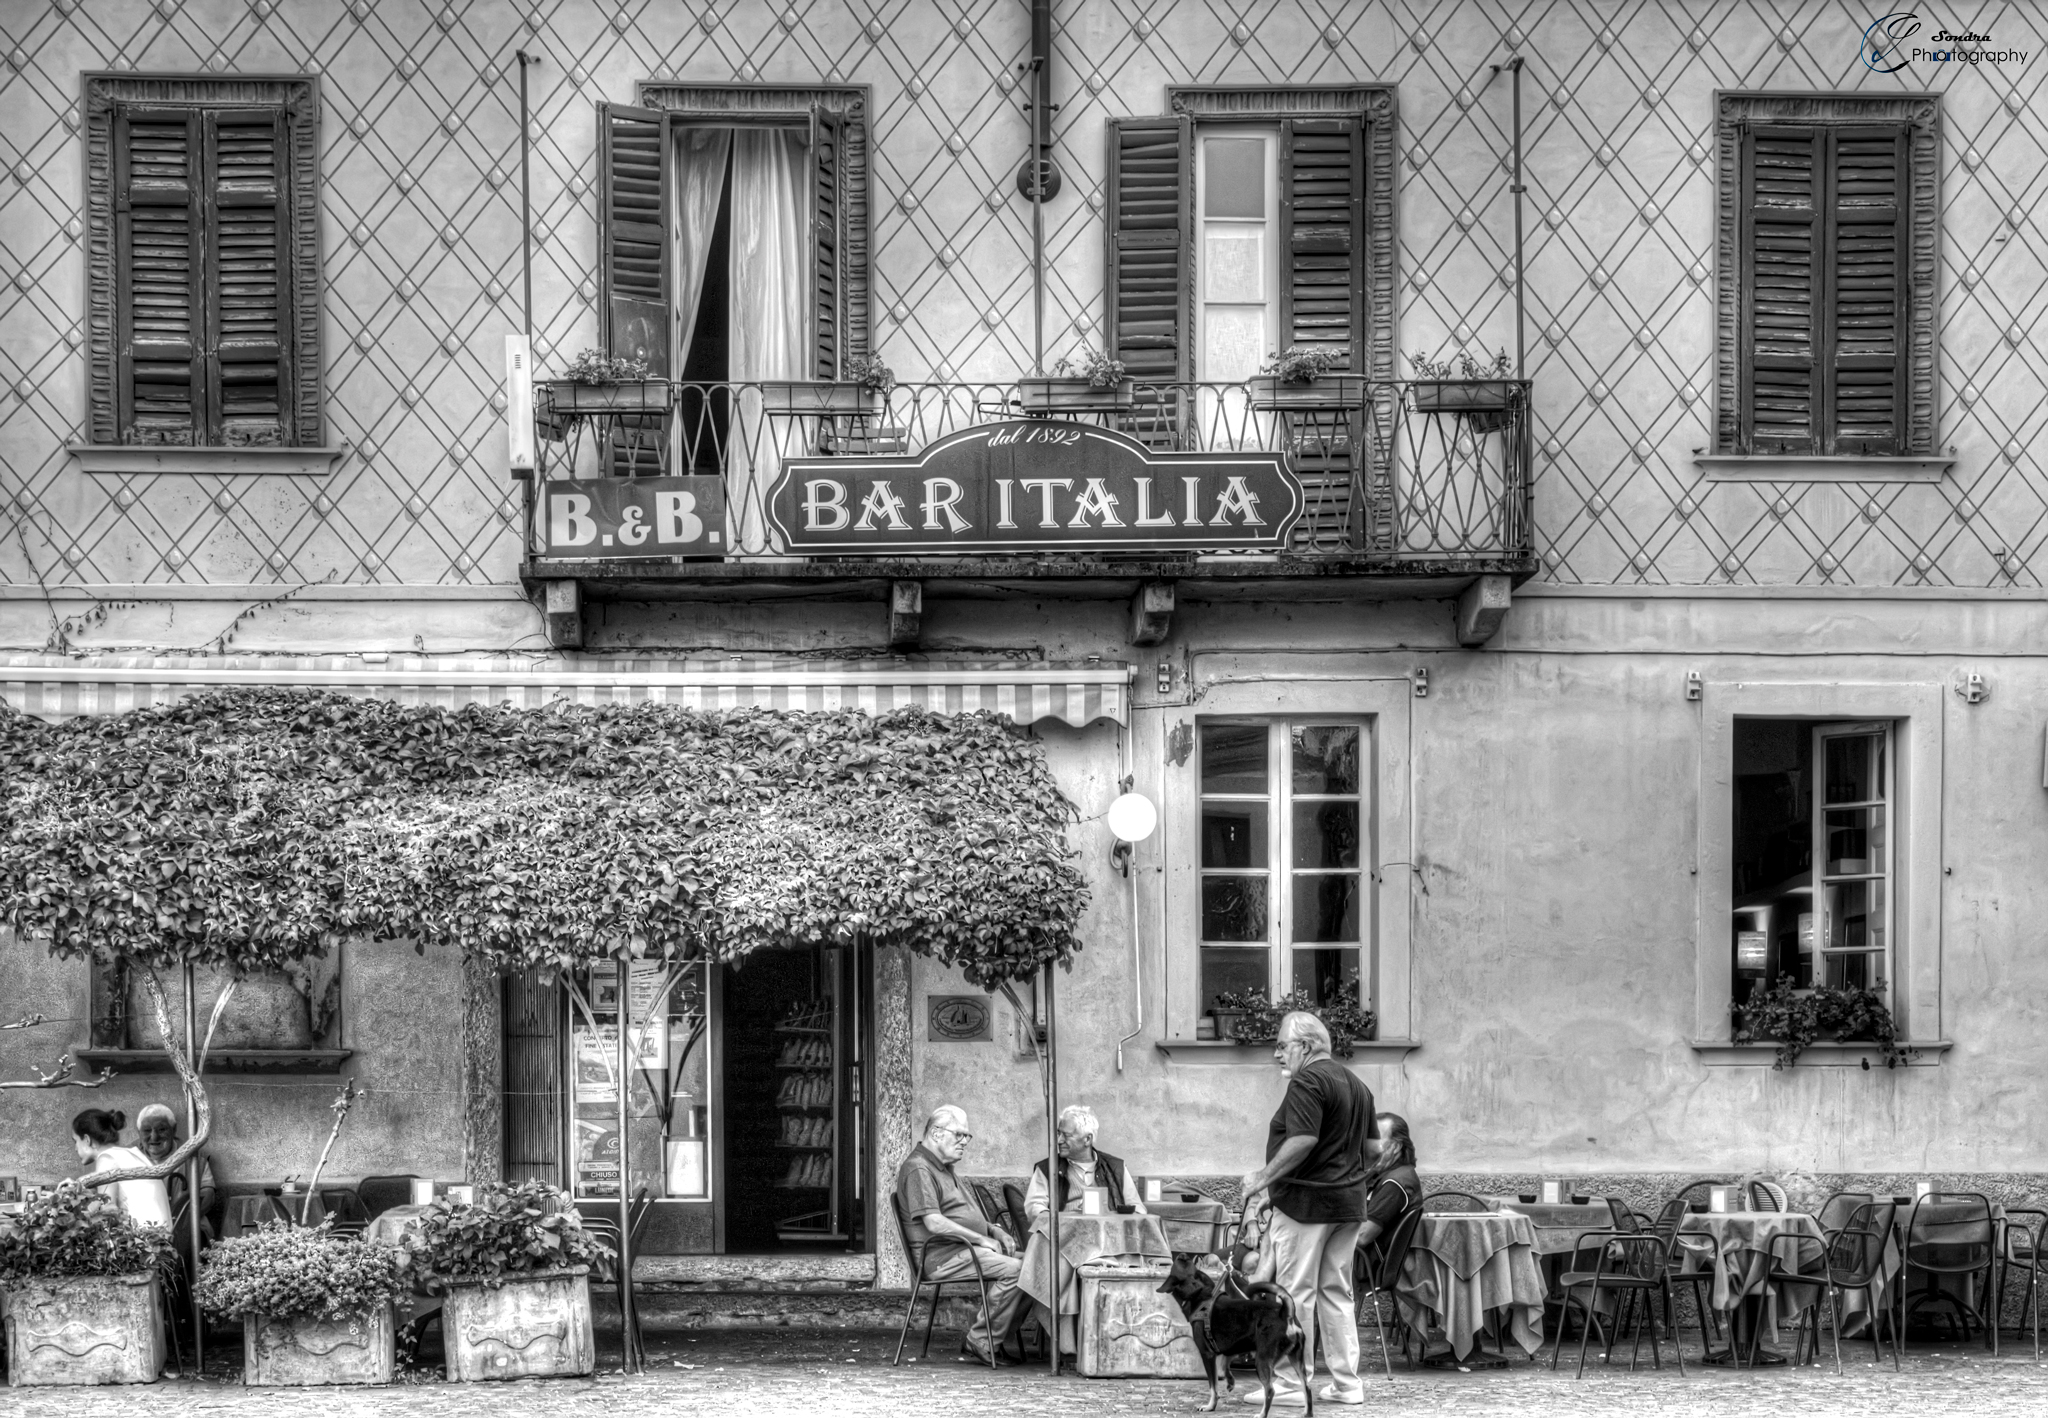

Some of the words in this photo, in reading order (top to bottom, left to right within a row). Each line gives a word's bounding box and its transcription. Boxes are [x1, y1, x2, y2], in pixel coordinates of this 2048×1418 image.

[987, 424, 1027, 447] dal
[1026, 427, 1081, 446] 1892
[801, 477, 973, 534] BAR
[995, 476, 1268, 529] ITALIA
